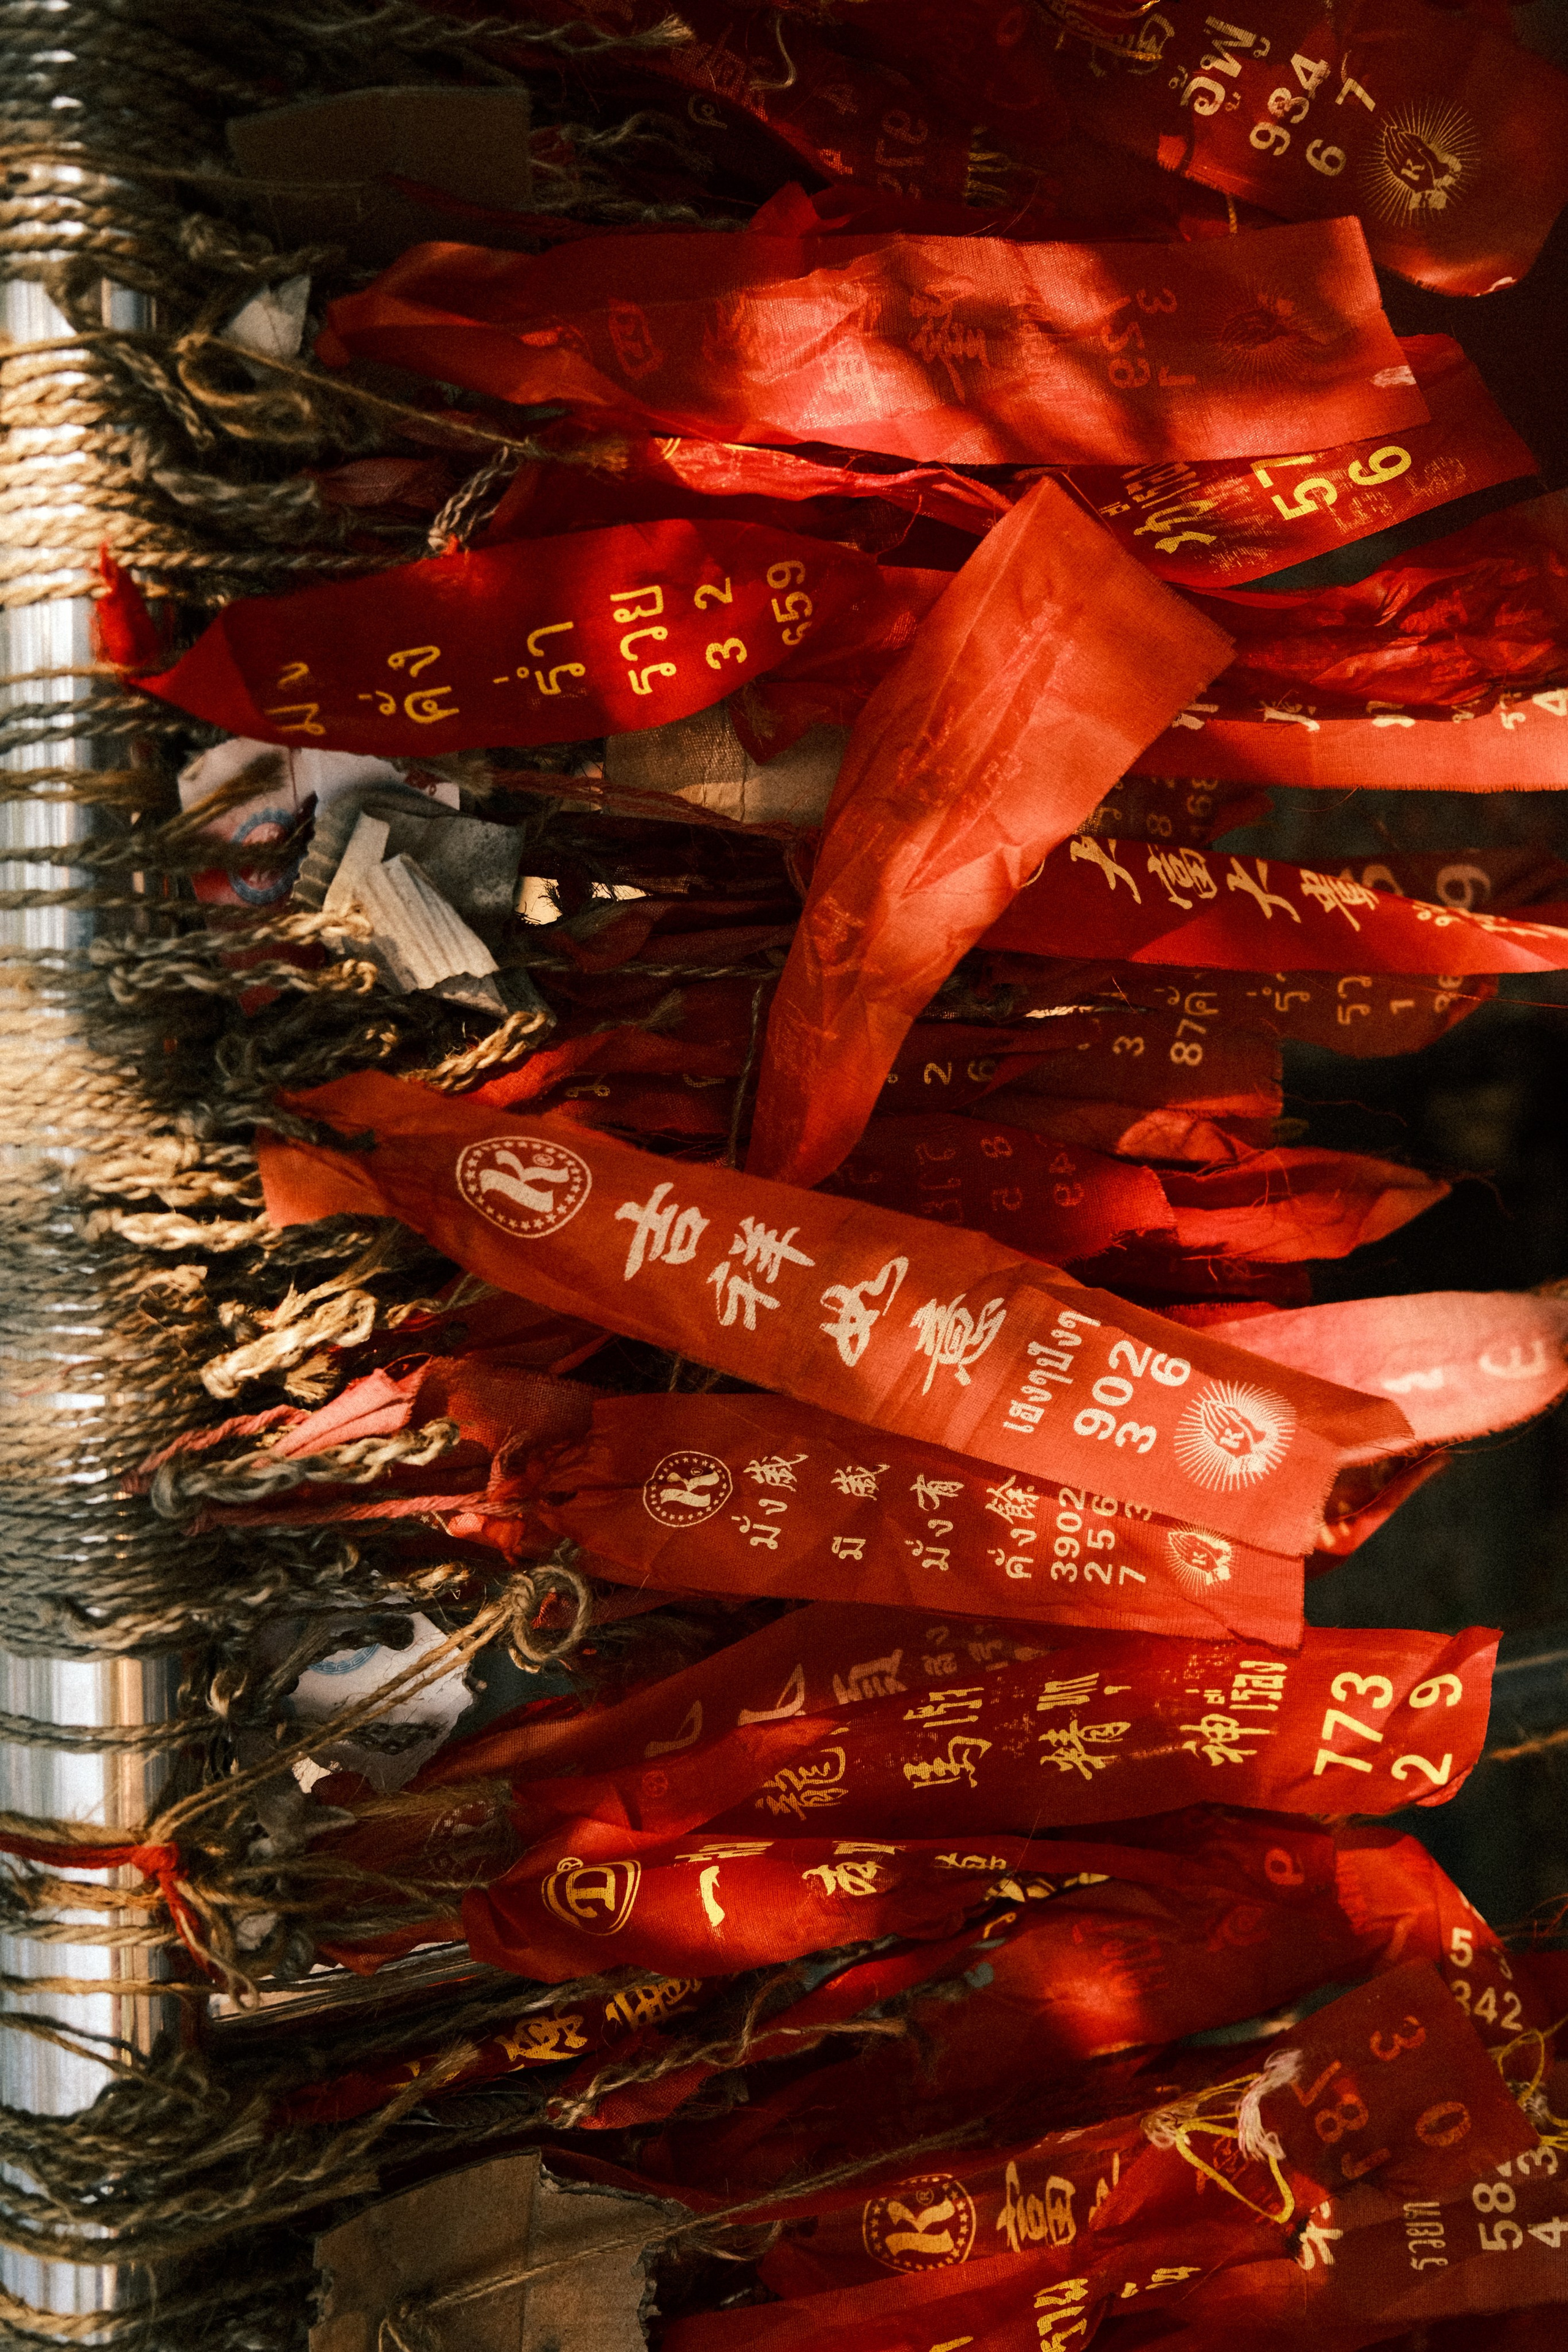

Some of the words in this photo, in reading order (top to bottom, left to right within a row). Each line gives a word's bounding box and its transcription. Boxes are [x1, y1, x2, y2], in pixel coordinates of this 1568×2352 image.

[1249, 53, 1331, 156] 934
[1306, 138, 1347, 176] 6
[1335, 77, 1376, 112] 7
[1251, 453, 1340, 521] 57
[1346, 444, 1413, 487] 6
[694, 577, 733, 610] 2
[493, 621, 586, 696] ร่ำ
[609, 584, 677, 696] รวย
[705, 637, 747, 670] 3
[357, 644, 460, 724] คั่ง
[1169, 1018, 1207, 1066] 87
[614, 1181, 1008, 1396] 吉祥如意
[1072, 1340, 1153, 1441] 902
[1115, 1421, 1157, 1453] 3
[1150, 1352, 1192, 1387] 6
[1050, 1487, 1087, 1583] 3902
[1087, 1529, 1115, 1551] 5
[1091, 1495, 1119, 1517] 6
[987, 1529, 1038, 1579] คั่ง
[1084, 1561, 1114, 1585] 2
[1119, 1564, 1147, 1586] 7
[1313, 1671, 1394, 1776] 773
[1409, 1672, 1463, 1709] 9
[755, 1713, 1278, 1820] 龍馬精神
[1390, 1753, 1453, 1785] 2
[1449, 1926, 1474, 1969] 5
[1471, 2162, 1524, 2252] 58
